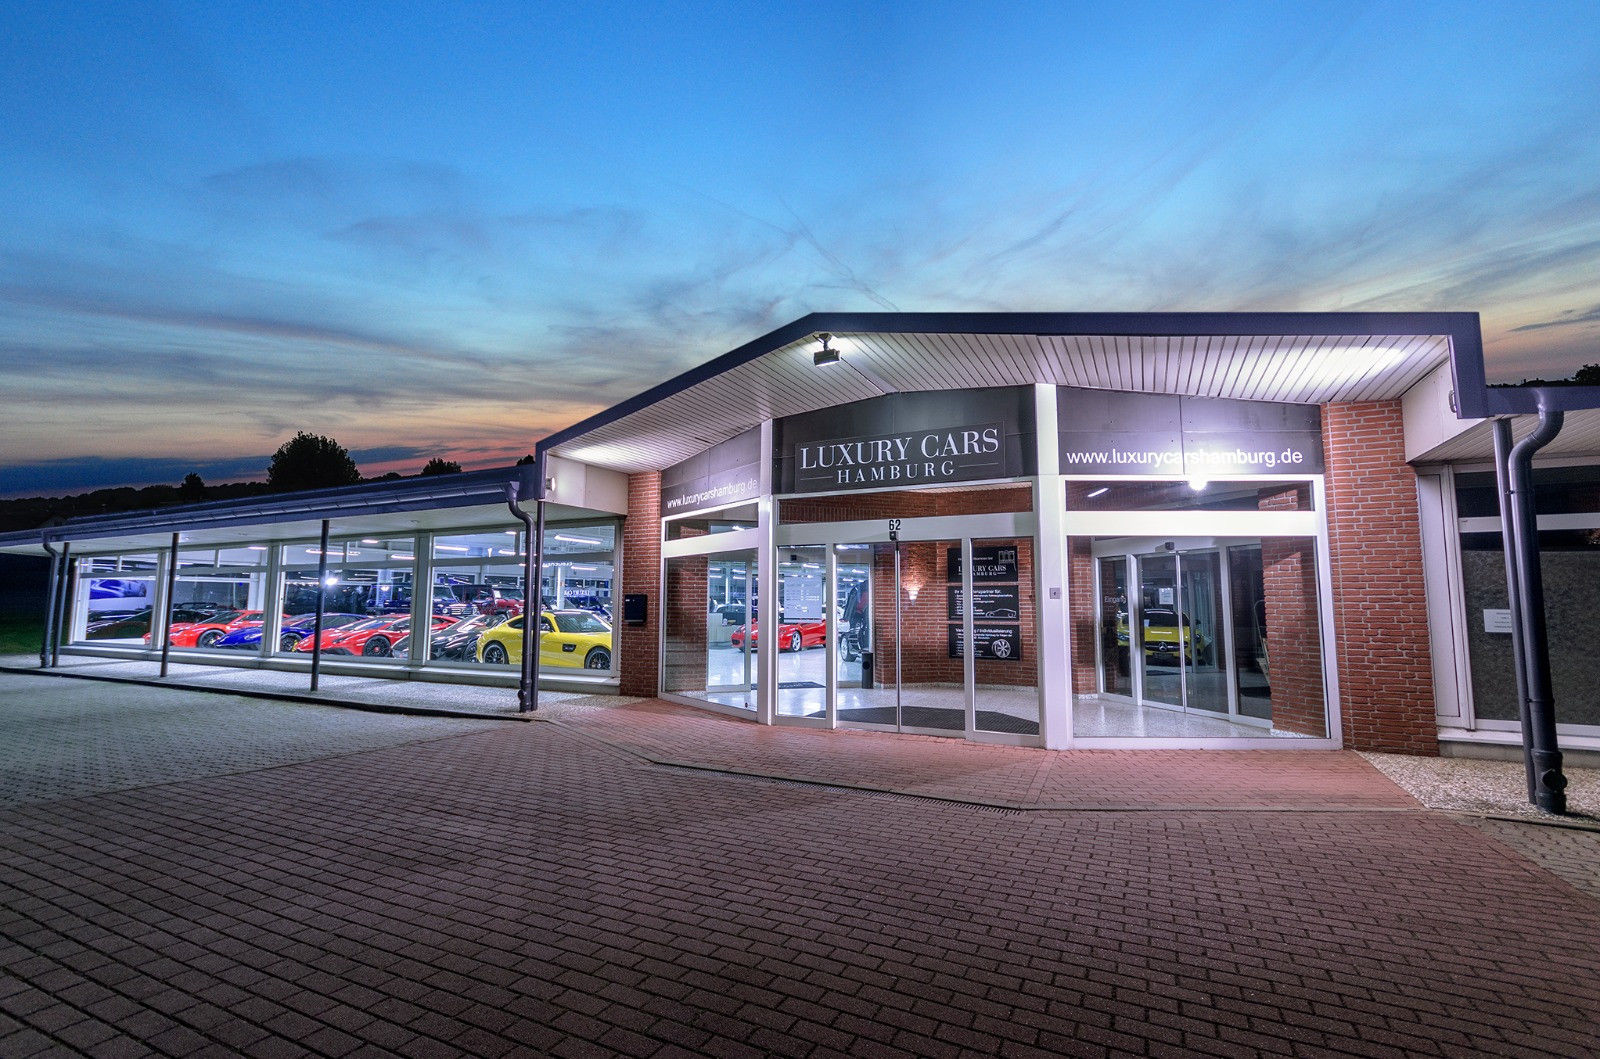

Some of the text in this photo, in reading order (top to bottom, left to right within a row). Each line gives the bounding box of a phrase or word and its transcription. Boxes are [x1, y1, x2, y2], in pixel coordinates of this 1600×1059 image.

[800, 428, 1000, 469] LUXURY CARS
[1066, 448, 1304, 467] www.luxurycarshamburg.de
[836, 460, 954, 484] HAMBURG
[667, 478, 758, 509] www.luxurycarshamburg.de
[889, 520, 901, 530] 62
